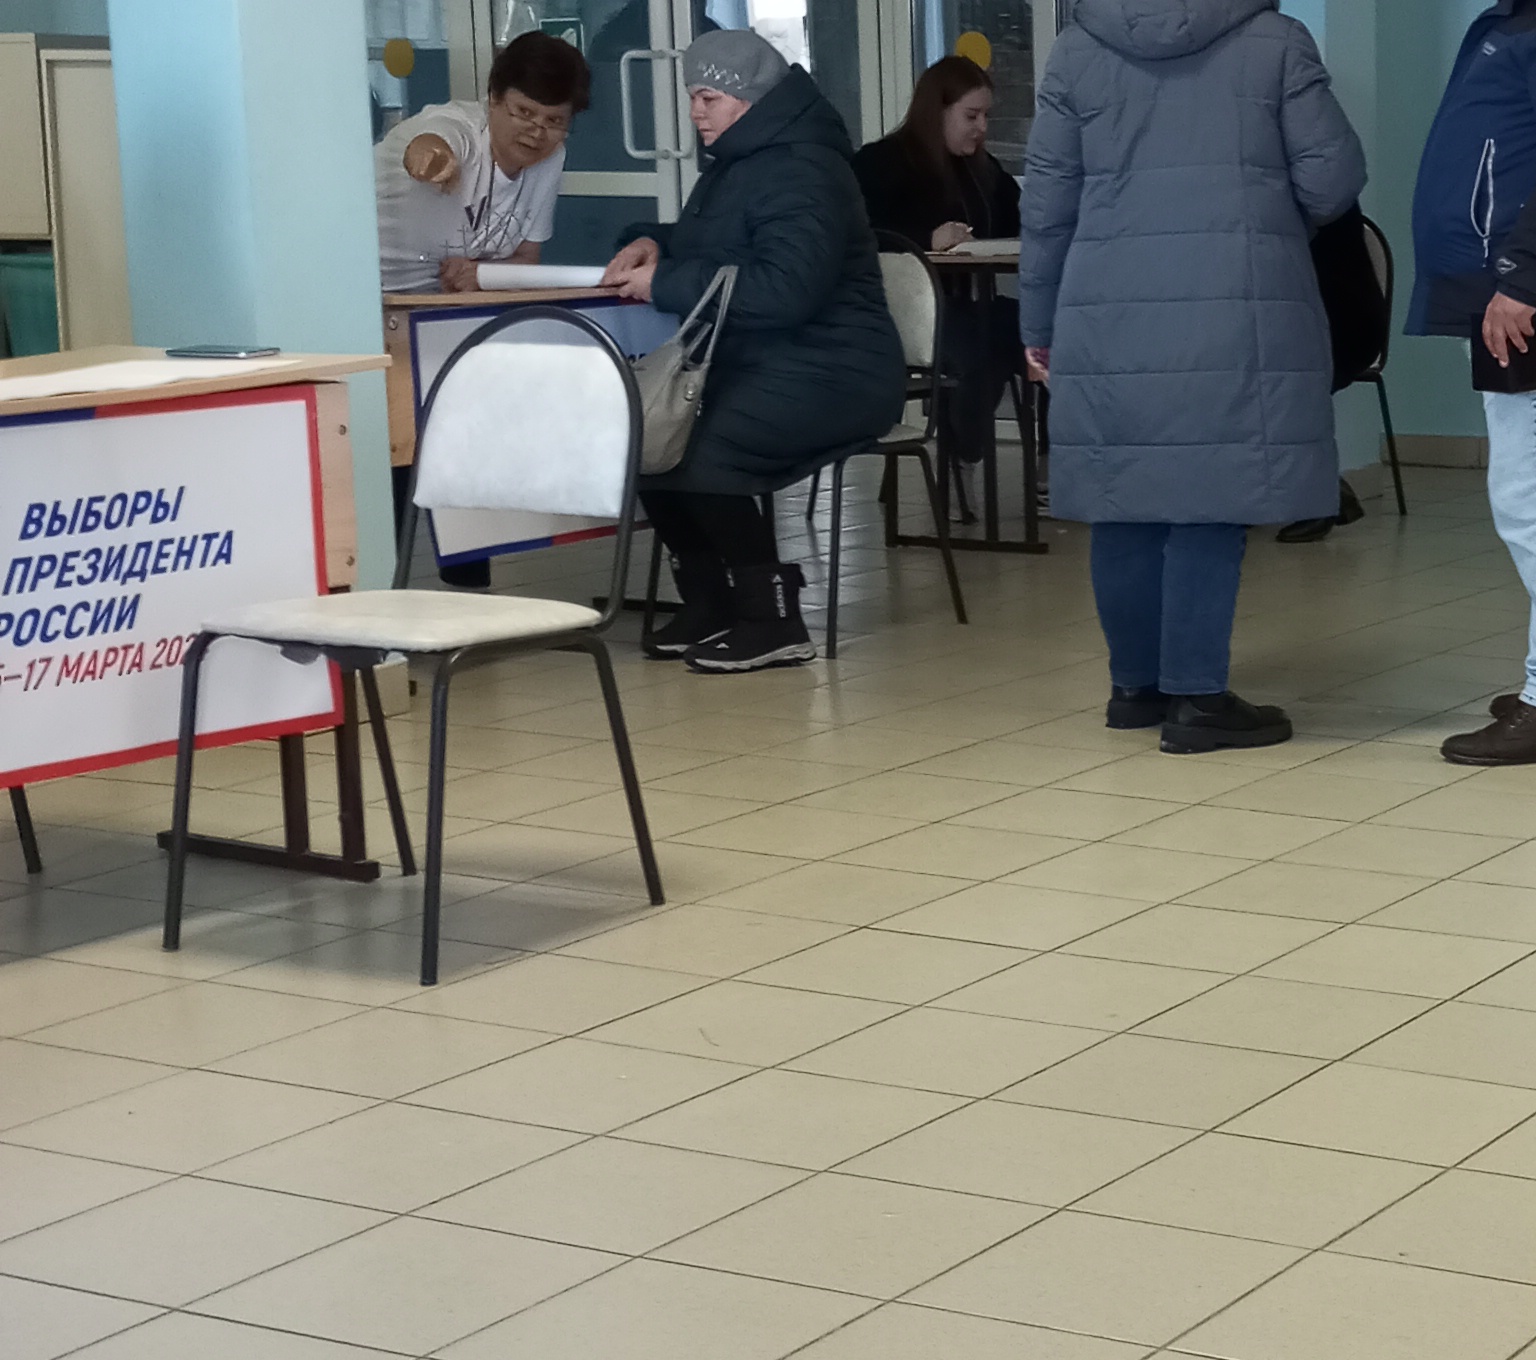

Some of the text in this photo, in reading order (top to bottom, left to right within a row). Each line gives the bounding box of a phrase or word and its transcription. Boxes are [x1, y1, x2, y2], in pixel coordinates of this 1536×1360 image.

[18, 486, 186, 541] ВЫБОРЫ
[1, 530, 234, 596] ПРЕЗИДЕНТА
[55, 642, 145, 687] МАРТА
